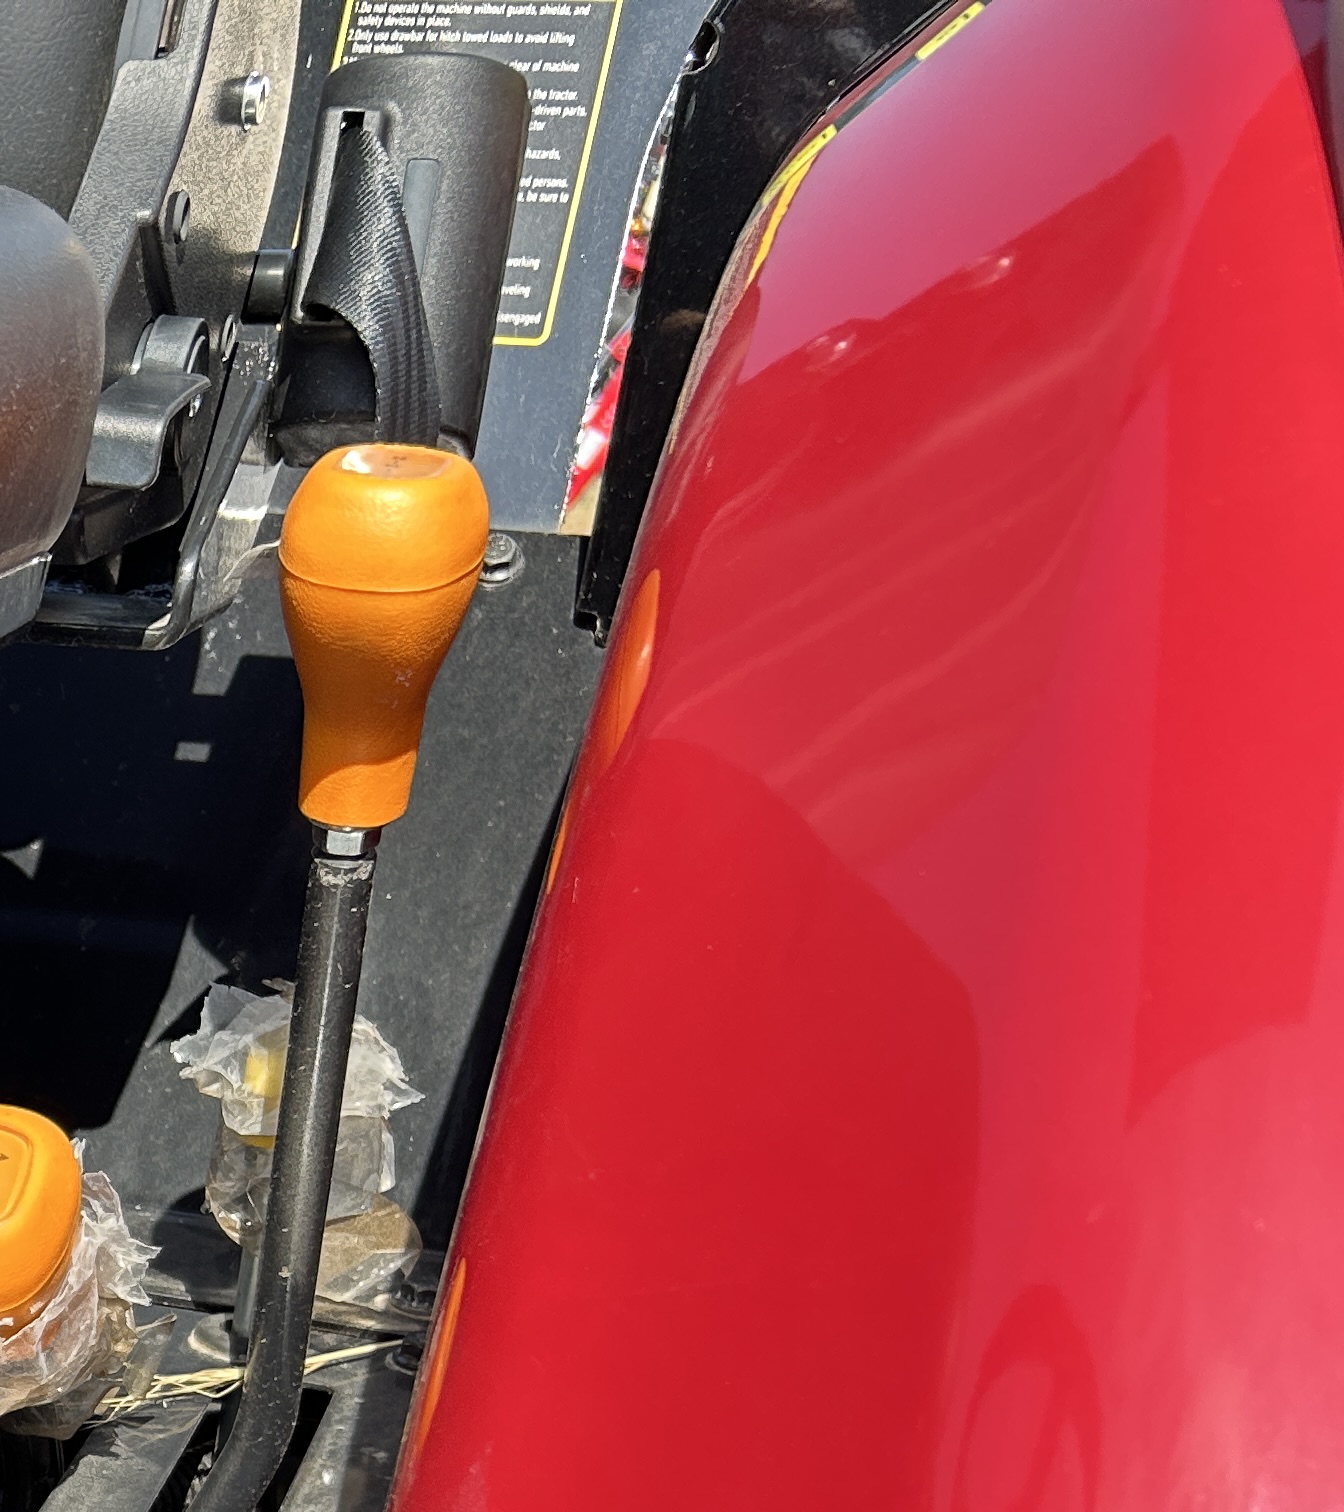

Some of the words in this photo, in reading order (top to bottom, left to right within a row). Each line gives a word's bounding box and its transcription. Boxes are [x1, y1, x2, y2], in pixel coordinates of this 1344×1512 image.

[354, 1, 372, 14] 1.Do
[373, 2, 387, 14] not
[388, 2, 419, 16] operate
[420, 2, 435, 14] the
[436, 2, 472, 15] machine
[473, 3, 506, 15] without
[506, 4, 537, 17] guards,
[539, 3, 572, 16] shields,
[572, 3, 592, 16] and
[357, 14, 384, 29] safety
[384, 14, 415, 27] devices
[416, 14, 426, 26] in
[425, 15, 452, 28] place.
[347, 28, 373, 43] 2.Only
[373, 31, 390, 42] use
[390, 29, 425, 42] drawbar
[425, 29, 438, 42] for
[439, 30, 461, 42] hitch
[462, 31, 489, 43] towed
[489, 30, 513, 43] loads
[514, 31, 524, 43] to
[524, 31, 550, 44] avoid
[549, 31, 575, 47] lifting
[351, 42, 372, 54] front
[373, 42, 405, 54] wheels.
[532, 59, 543, 72] of
[542, 60, 580, 73] machine
[533, 88, 548, 100] the
[549, 89, 579, 100] tractor.
[531, 104, 561, 116] -driven
[562, 107, 588, 118] parts.
